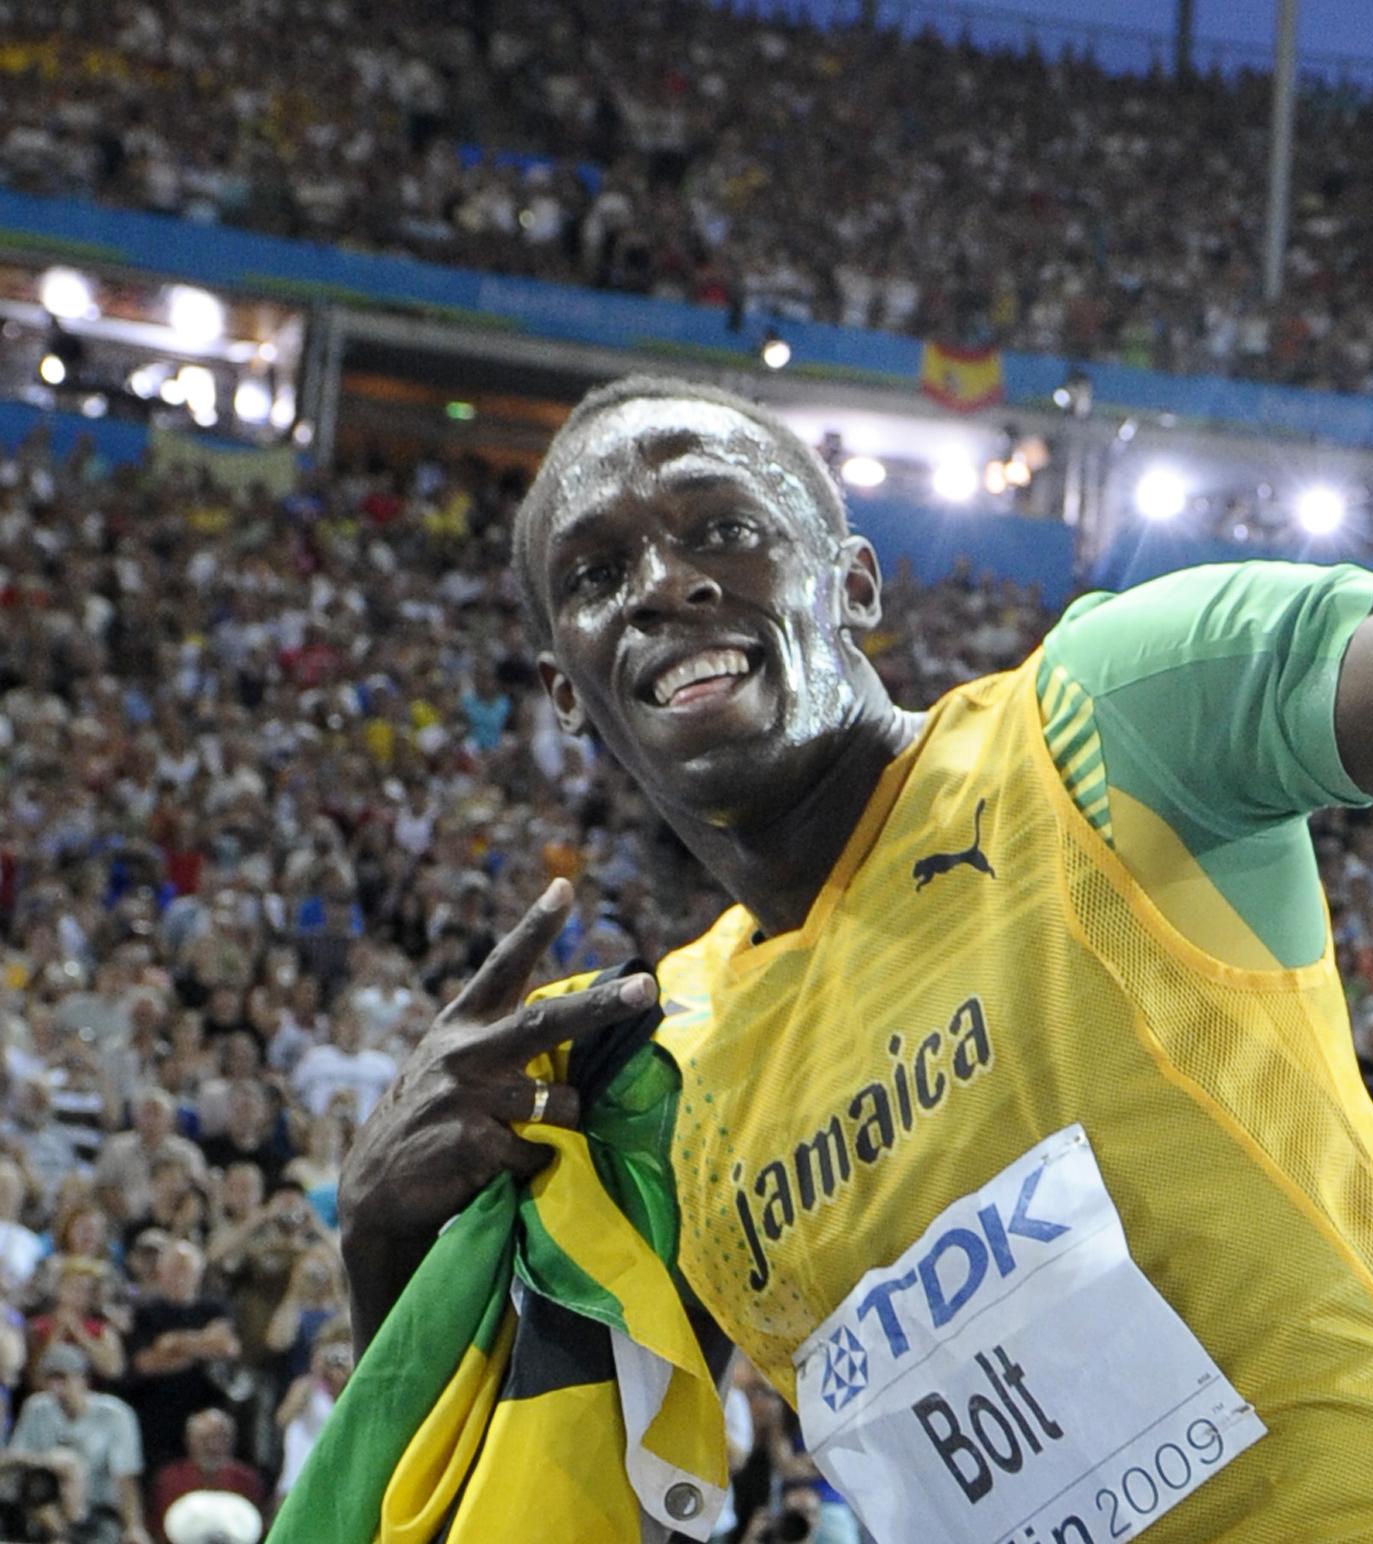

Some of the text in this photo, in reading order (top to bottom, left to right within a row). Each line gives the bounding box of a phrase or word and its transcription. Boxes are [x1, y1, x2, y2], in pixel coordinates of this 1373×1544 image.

[733, 997, 991, 1292] jamaica
[856, 1165, 1072, 1360] TDK
[911, 1344, 1064, 1505] Bolt
[1095, 1418, 1224, 1538] 2009
